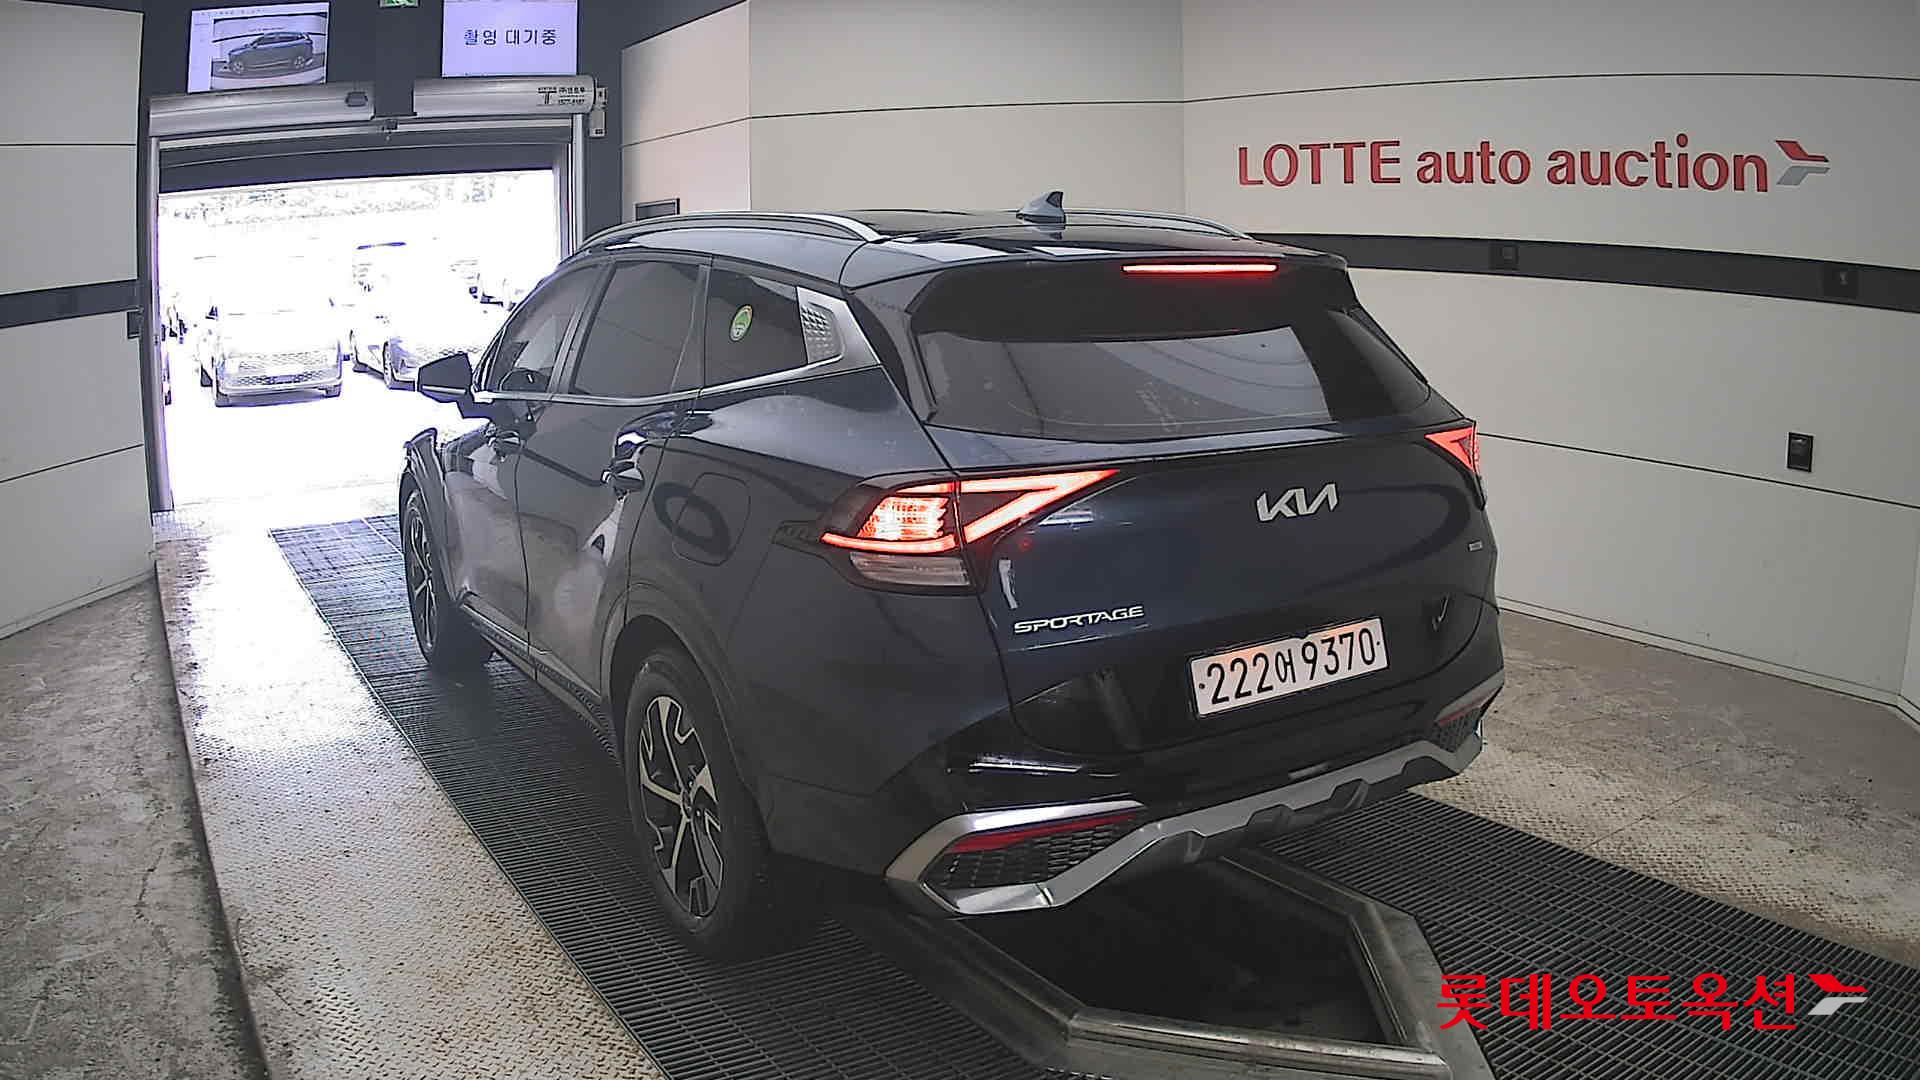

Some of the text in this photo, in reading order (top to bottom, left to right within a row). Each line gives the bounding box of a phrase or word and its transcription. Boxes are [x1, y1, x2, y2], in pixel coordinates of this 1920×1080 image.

[505, 29, 557, 46] 대기중
[1238, 133, 1769, 192] LOTTE auto auction
[1013, 605, 1145, 634] SPORTAGE
